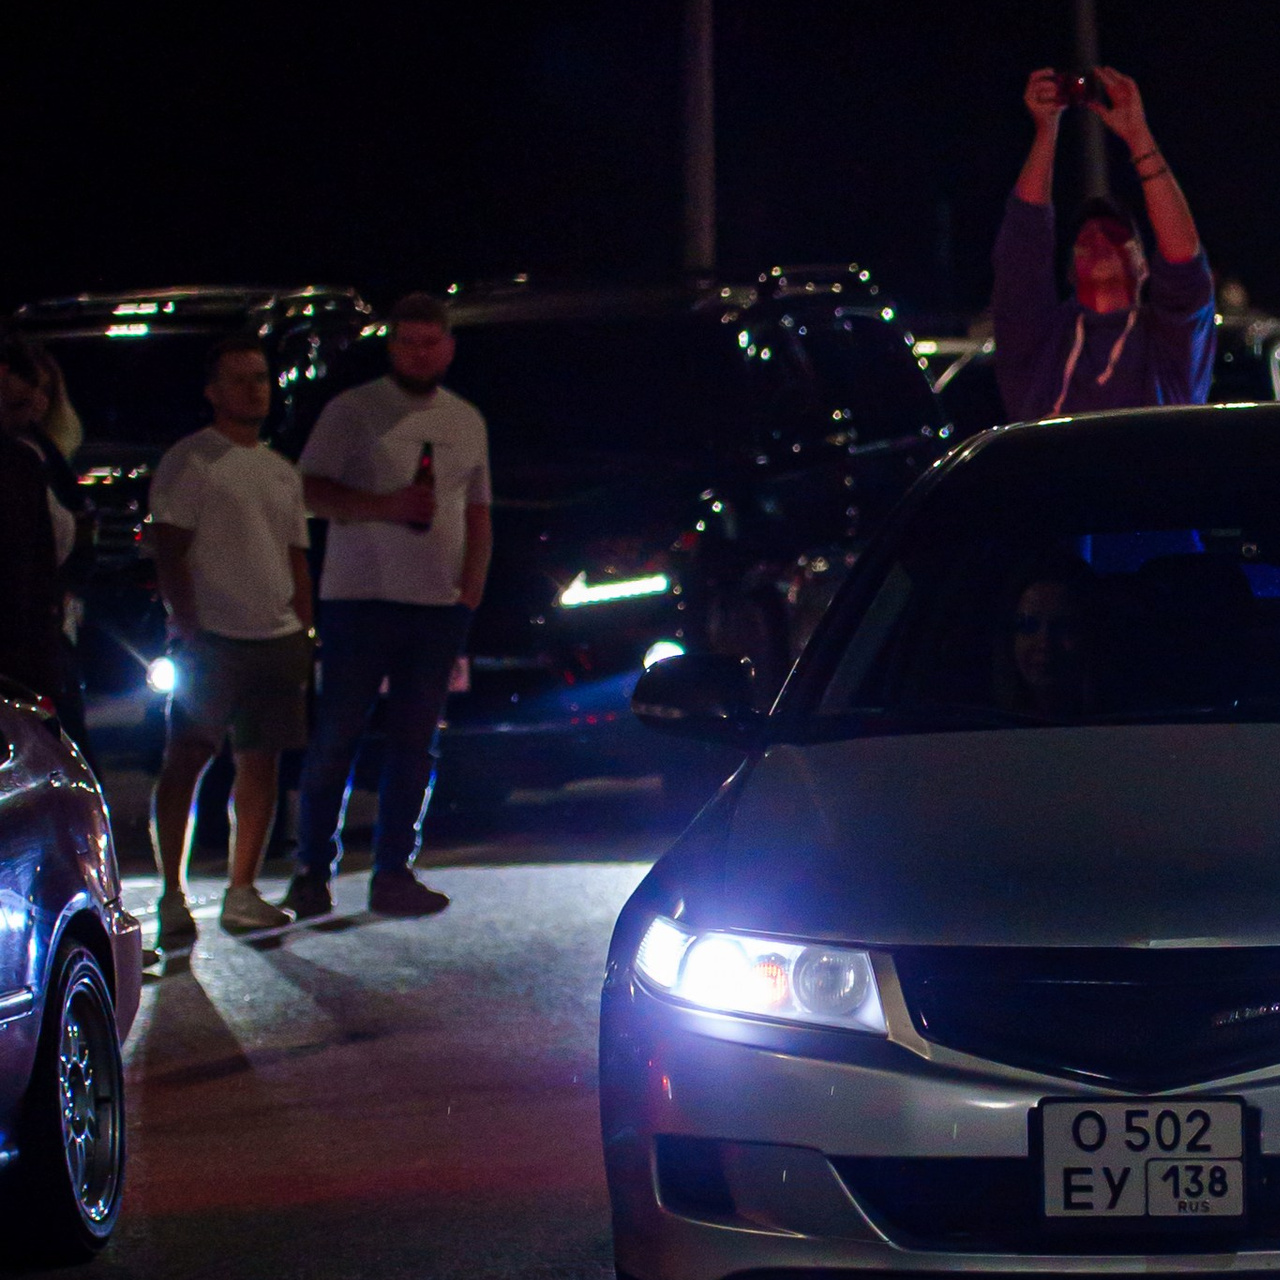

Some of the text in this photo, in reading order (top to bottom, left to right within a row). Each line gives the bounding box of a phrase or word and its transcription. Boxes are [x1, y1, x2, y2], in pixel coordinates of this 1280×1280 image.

[1124, 1108, 1212, 1153] 502
[1161, 1165, 1229, 1199] 138
[1177, 1200, 1211, 1213] RUS
